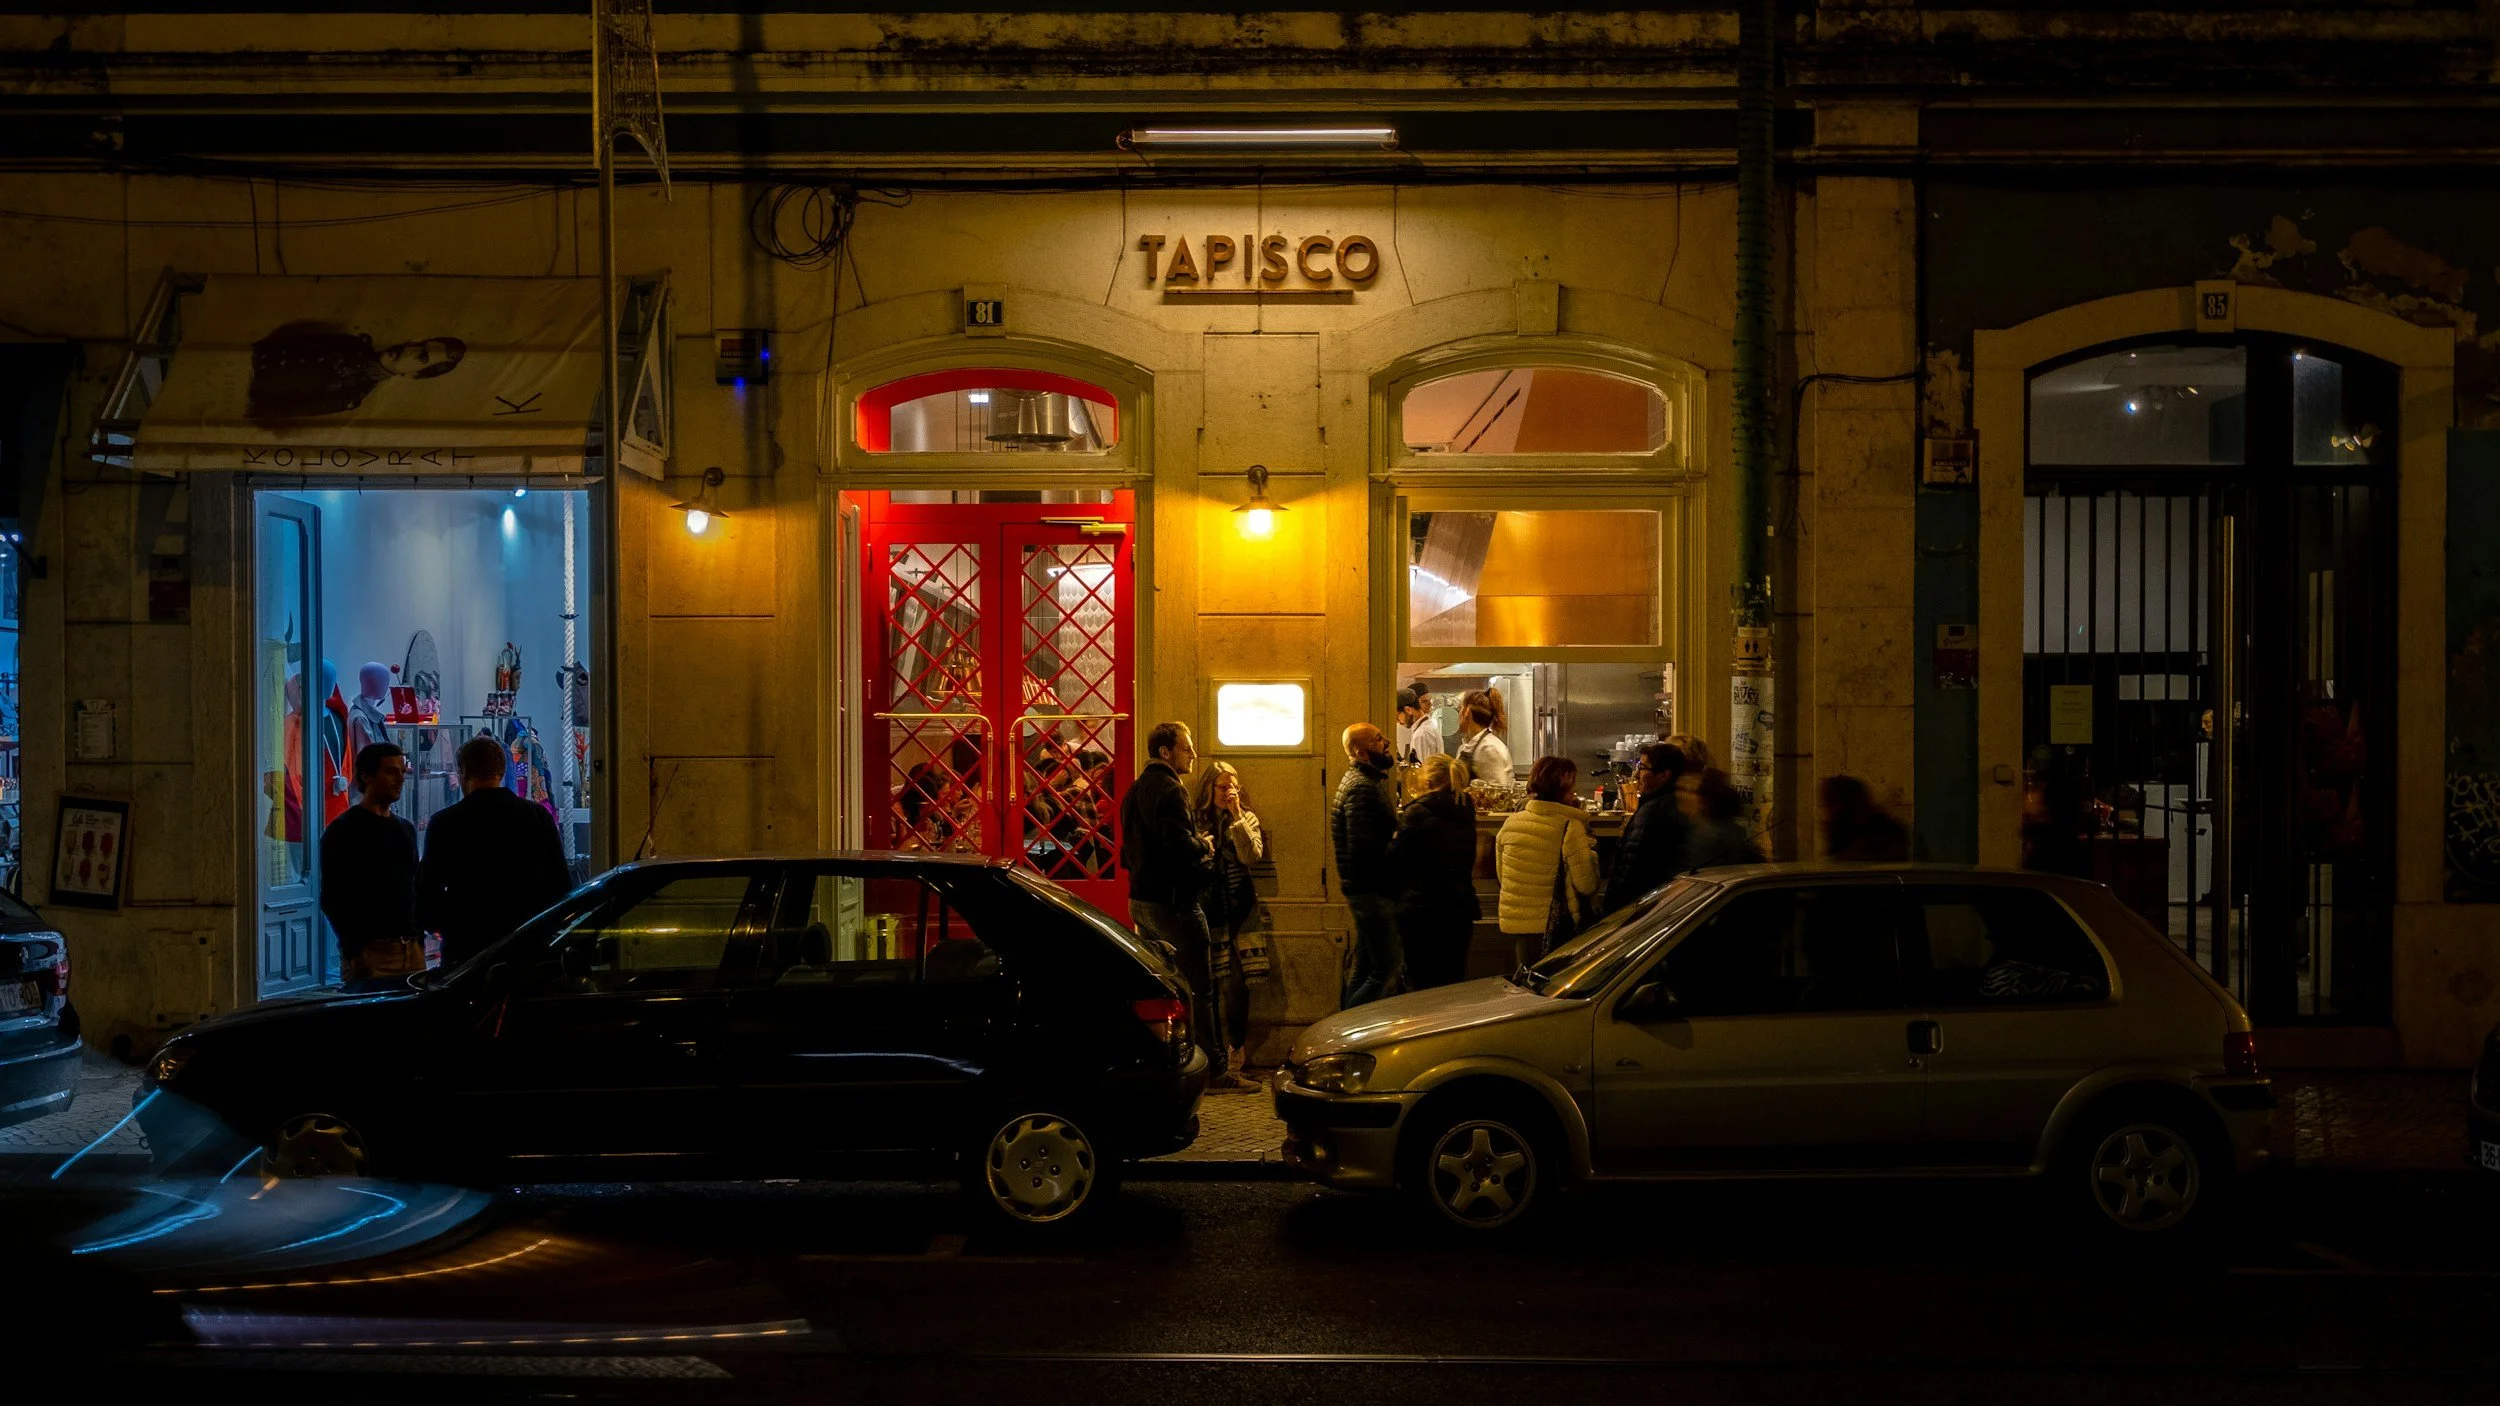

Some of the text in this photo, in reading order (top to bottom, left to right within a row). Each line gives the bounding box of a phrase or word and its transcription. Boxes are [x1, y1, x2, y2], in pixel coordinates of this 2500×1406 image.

[1139, 234, 1380, 282] TAPISCO
[975, 302, 994, 324] 81
[2207, 295, 2226, 317] 85
[492, 392, 543, 416] K
[243, 447, 476, 467] KOLOVRAT
